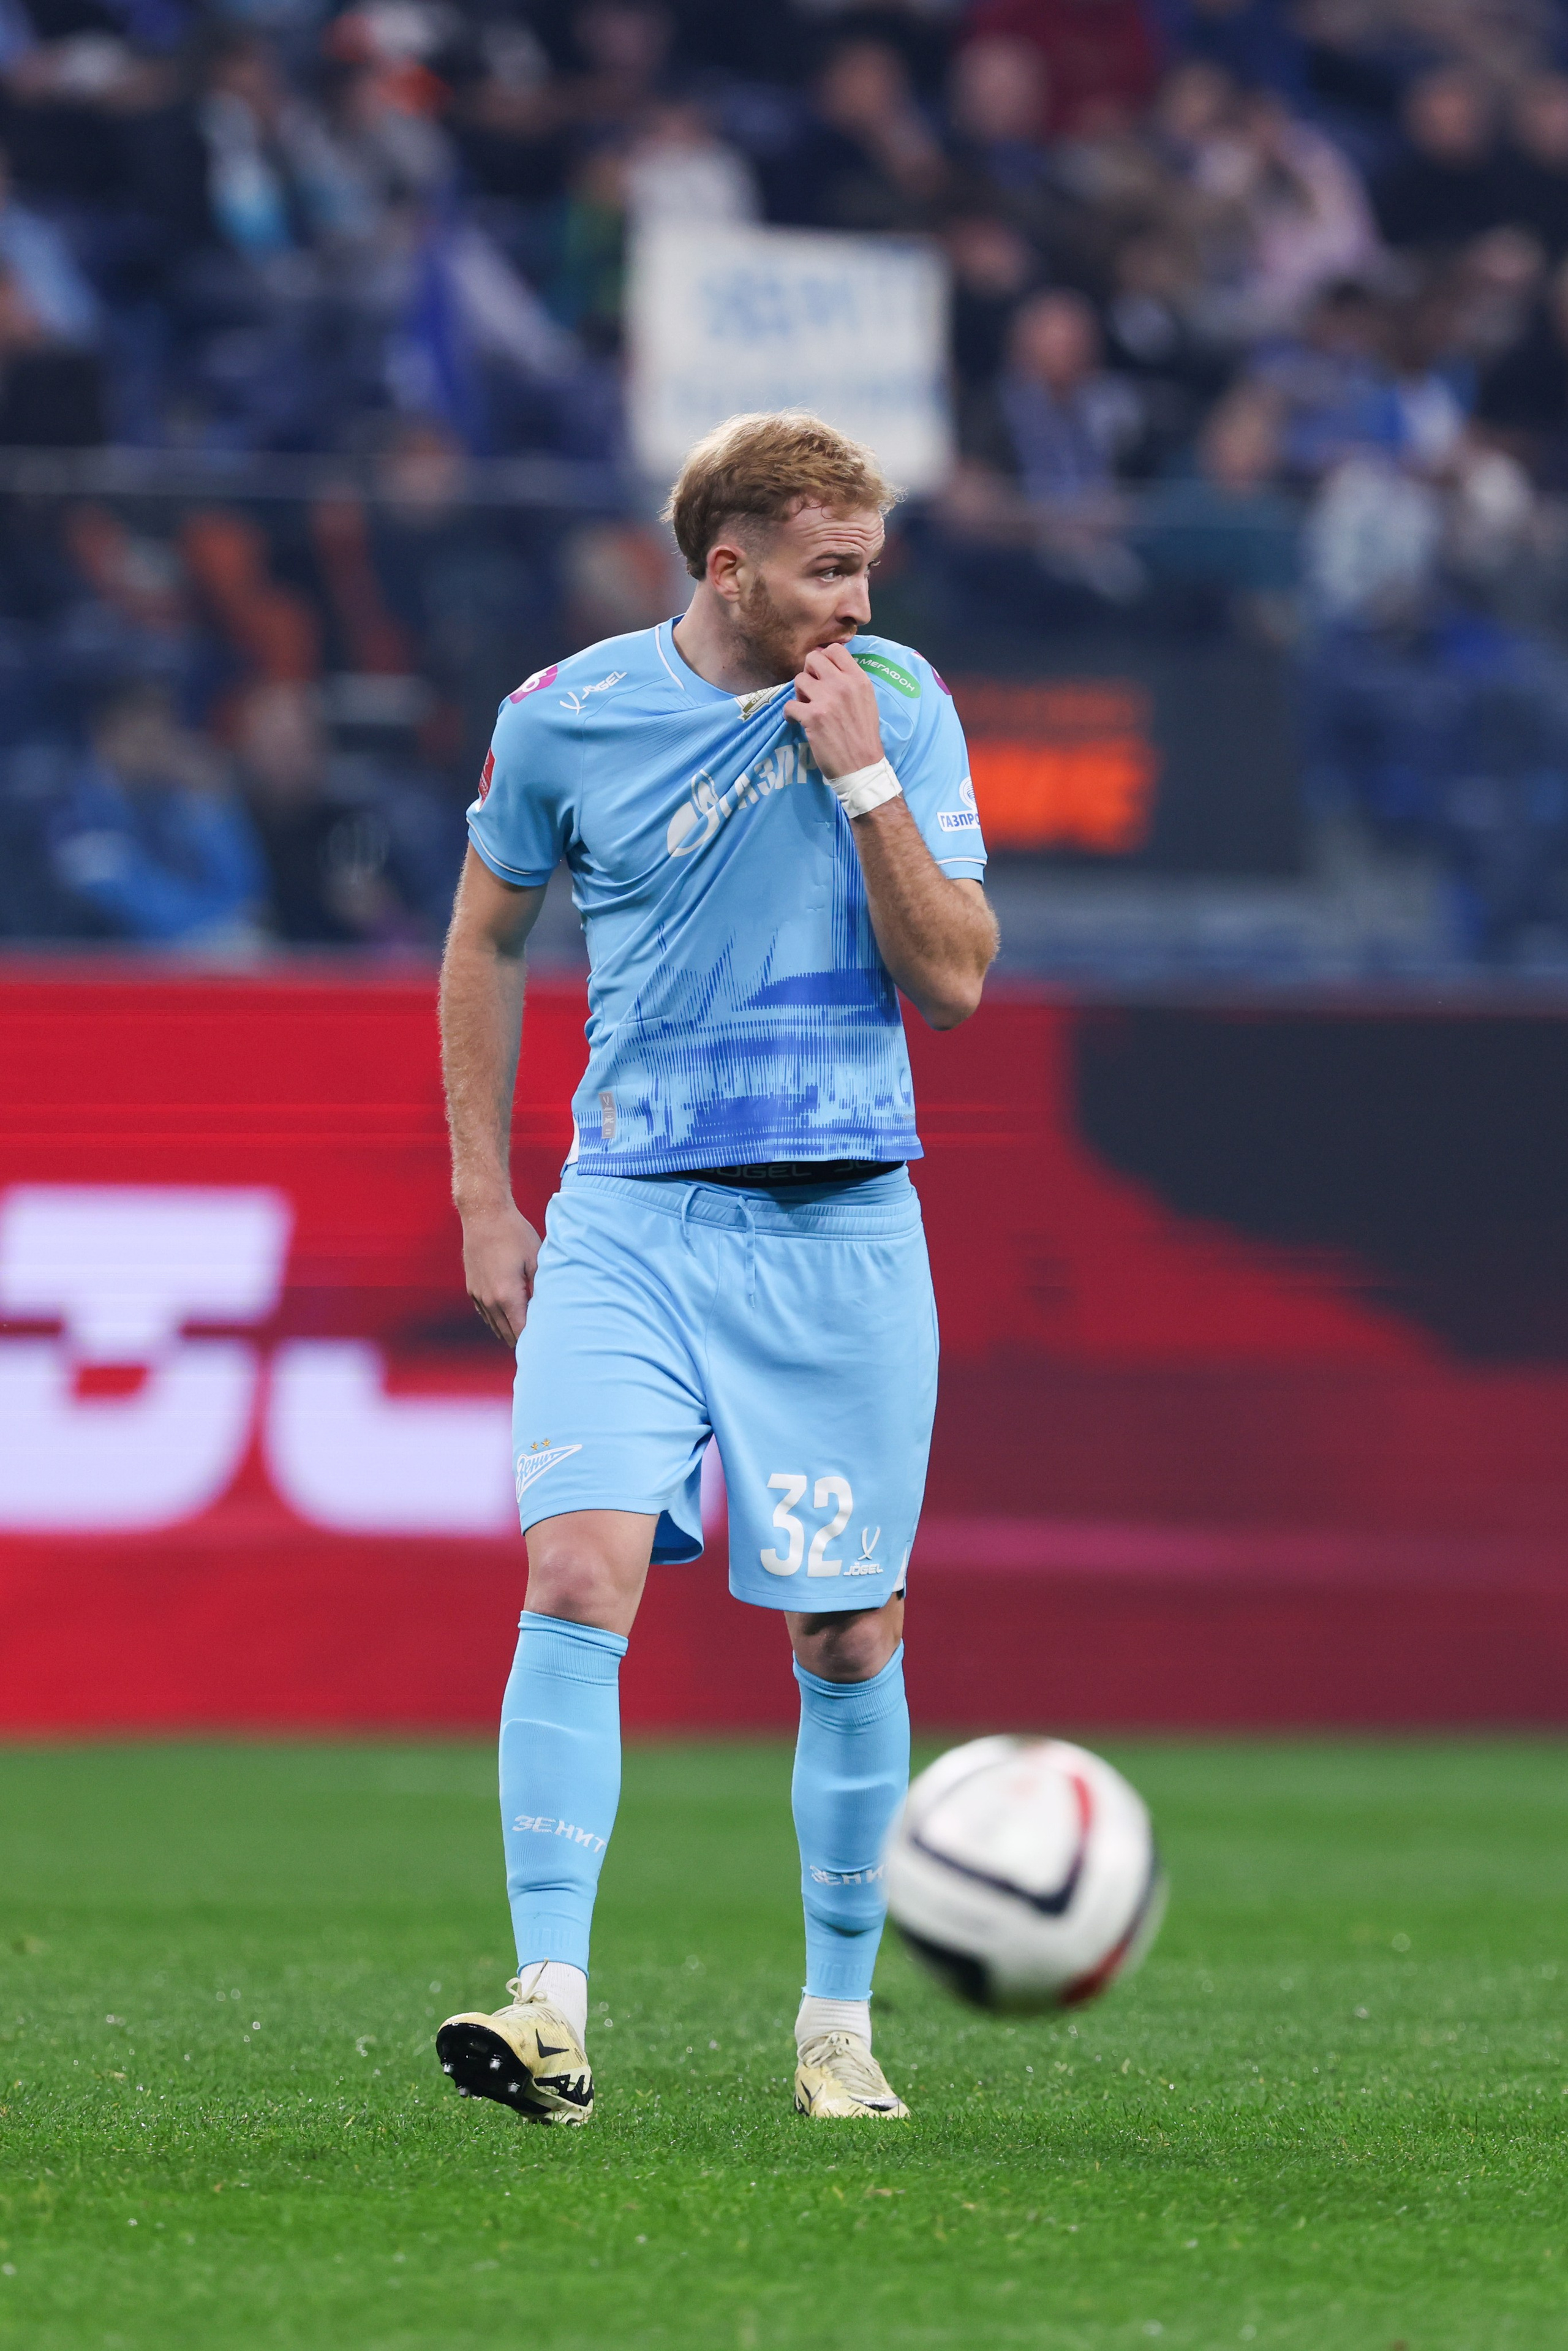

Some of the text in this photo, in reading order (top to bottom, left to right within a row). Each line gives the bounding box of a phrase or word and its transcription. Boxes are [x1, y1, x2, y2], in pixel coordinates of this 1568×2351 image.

[859, 659, 915, 692] МЕГАФОН
[760, 1473, 853, 1577] 32
[843, 1562, 884, 1576] JÖGEL
[512, 1815, 607, 1854] ЗЕНИТ
